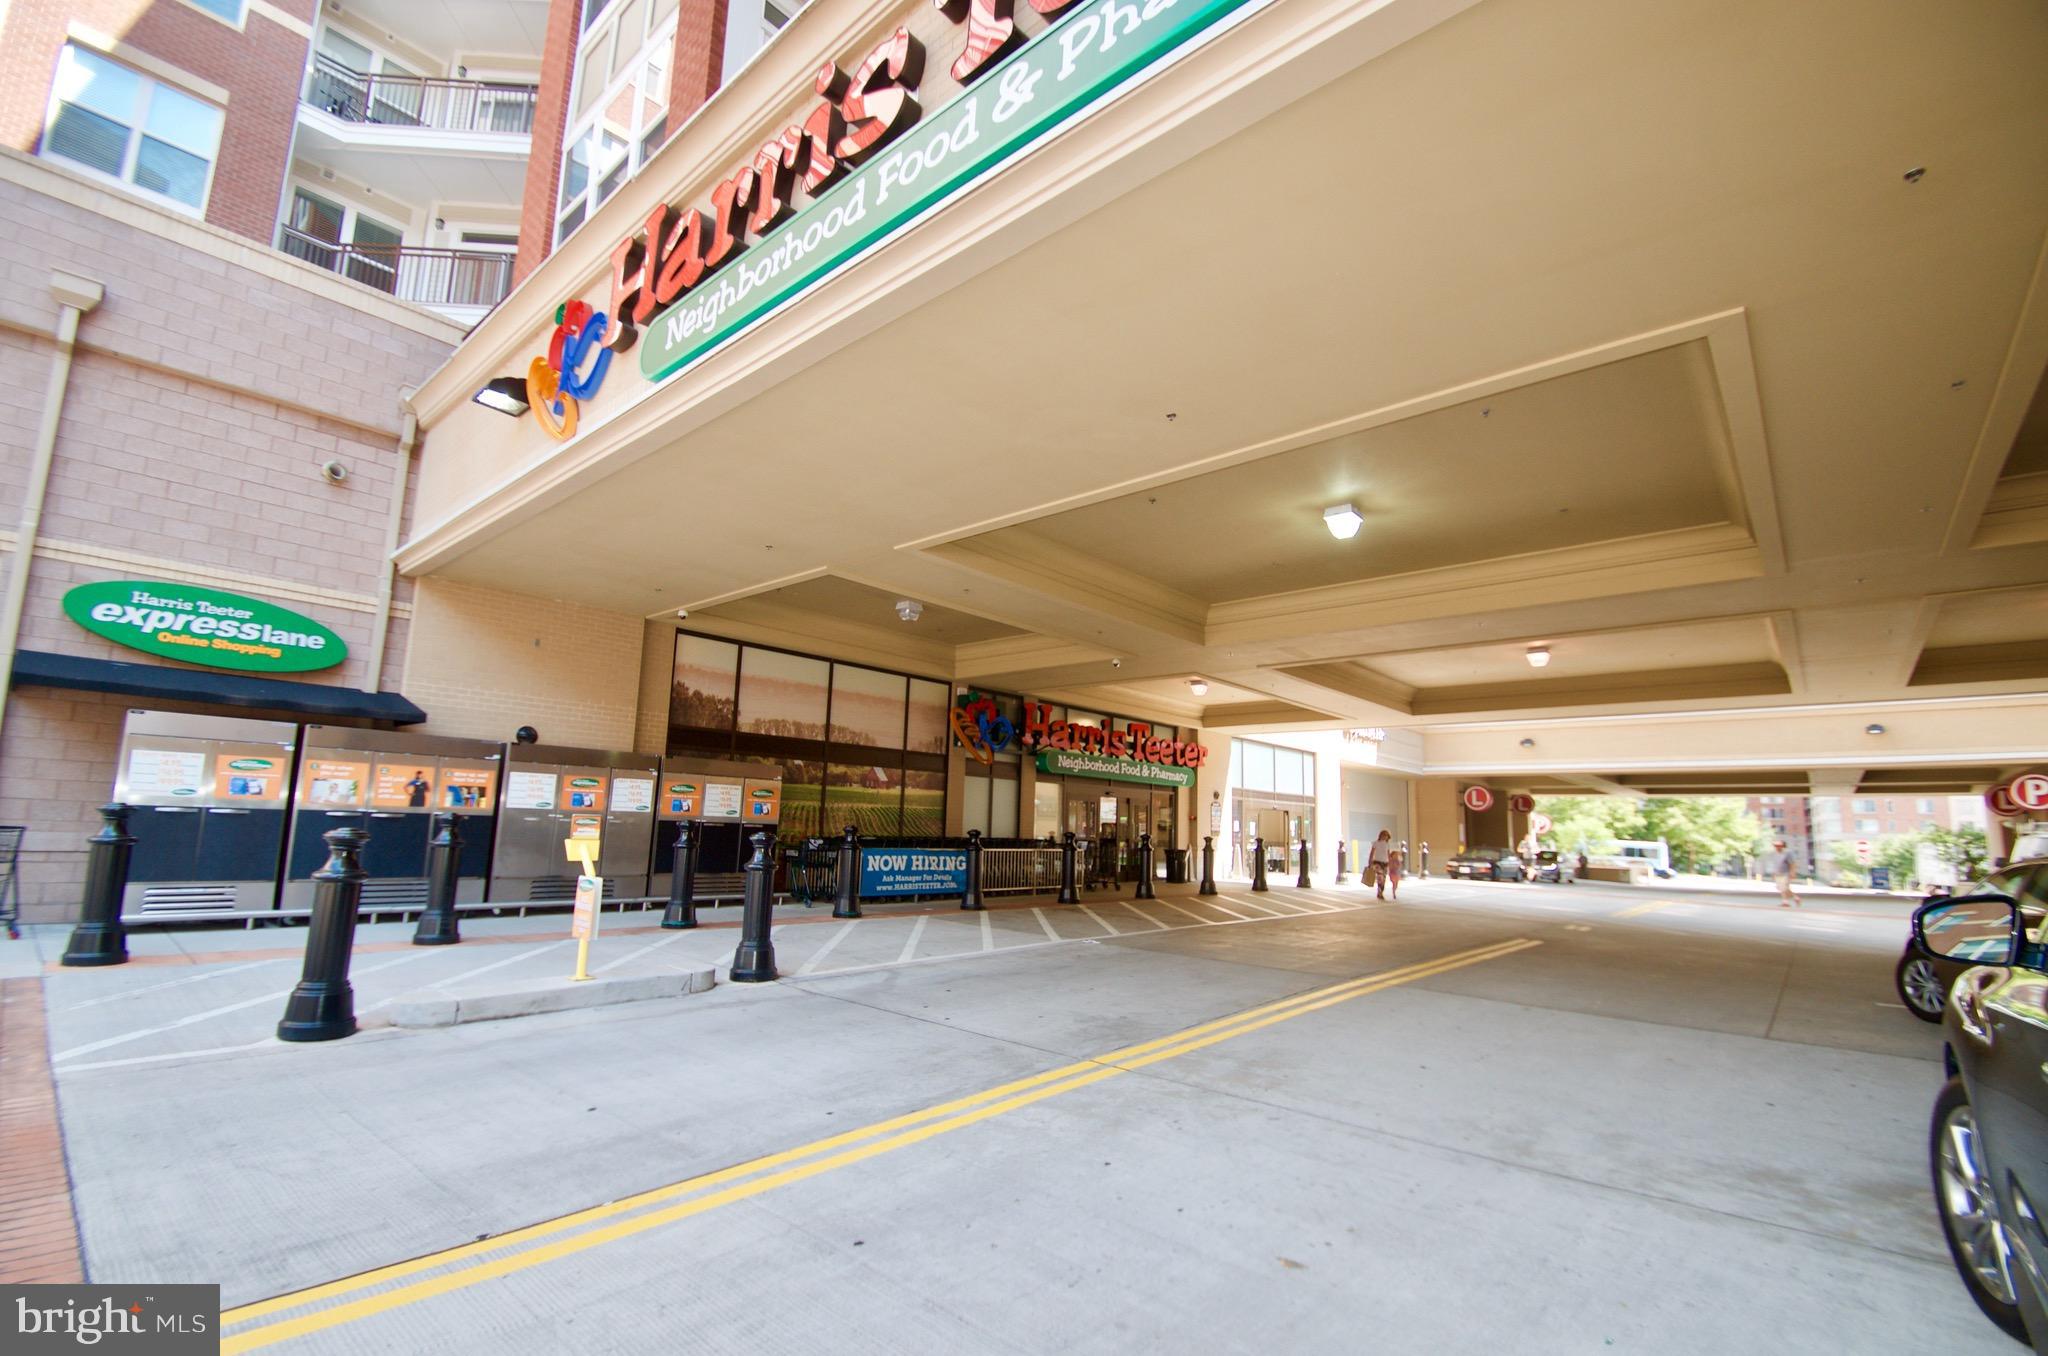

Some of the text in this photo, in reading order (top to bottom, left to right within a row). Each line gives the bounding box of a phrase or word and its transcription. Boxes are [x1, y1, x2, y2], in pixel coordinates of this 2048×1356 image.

[600, 25, 912, 350] Harris
[665, 177, 868, 350] Neighborhood
[876, 97, 980, 206] Food
[992, 60, 1043, 123] &
[131, 590, 254, 619] Harris Teeter
[157, 631, 282, 659] Online Shopping
[1021, 702, 1209, 768] Harris Teeter
[1058, 755, 1189, 783] Neighborhood Food & Pharmacy
[1471, 789, 1484, 806] L
[2024, 779, 2048, 805] P
[866, 855, 967, 872] NOW HIRING
[882, 874, 894, 882] Ask
[895, 874, 922, 883] Manager
